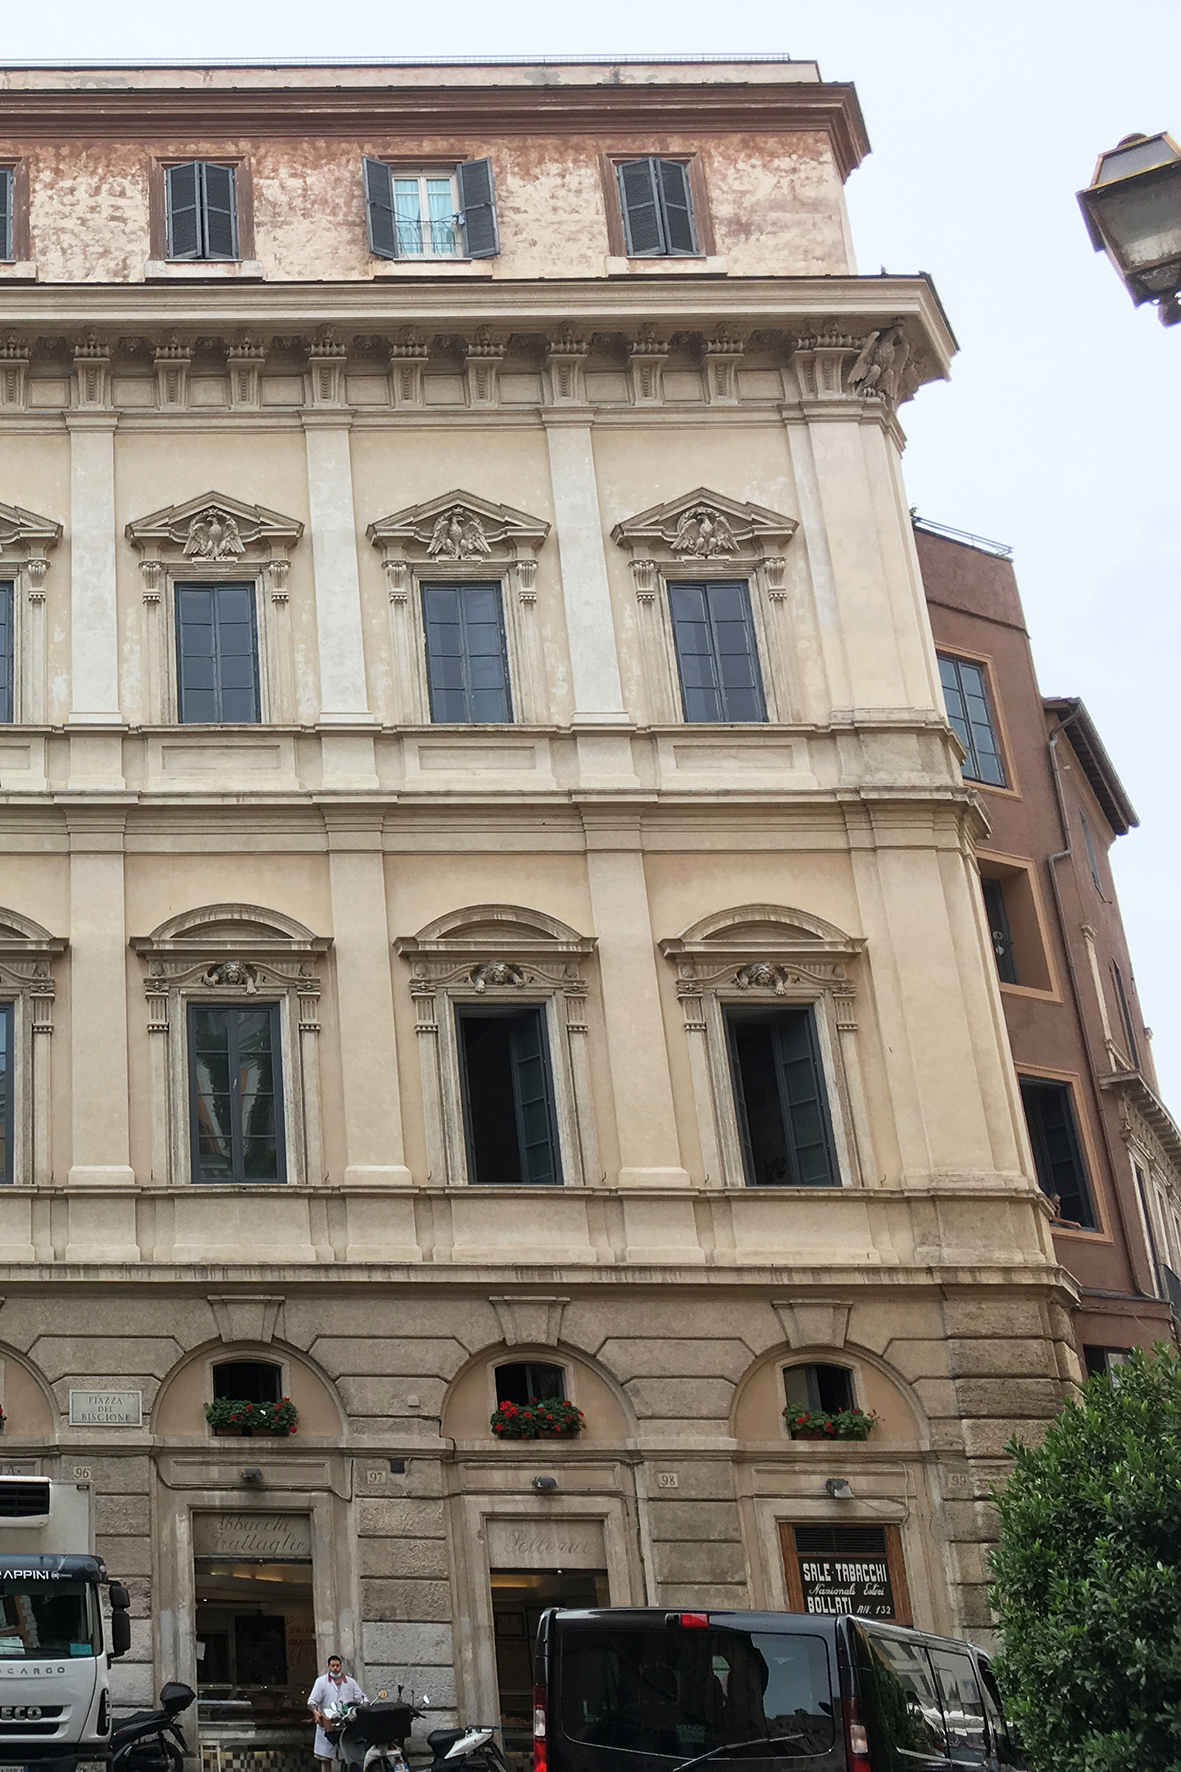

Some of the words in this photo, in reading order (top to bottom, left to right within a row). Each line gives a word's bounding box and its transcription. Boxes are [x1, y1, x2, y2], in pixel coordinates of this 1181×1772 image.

[88, 1396, 123, 1405] PIAZZA
[97, 1405, 113, 1413] DEL
[81, 1412, 131, 1422] BISCIONE
[74, 1467, 91, 1479] 96
[369, 1472, 383, 1483] 97
[660, 1475, 676, 1486] 98
[951, 1475, 967, 1486] 99
[205, 1514, 291, 1532] Abbacchi
[802, 1563, 832, 1582] SALE
[835, 1563, 887, 1582] TABACCHI
[809, 1583, 856, 1596] Nazionali
[863, 1583, 886, 1596] Esteri
[807, 1596, 853, 1614] BOLLATI
[875, 1605, 892, 1615] 132
